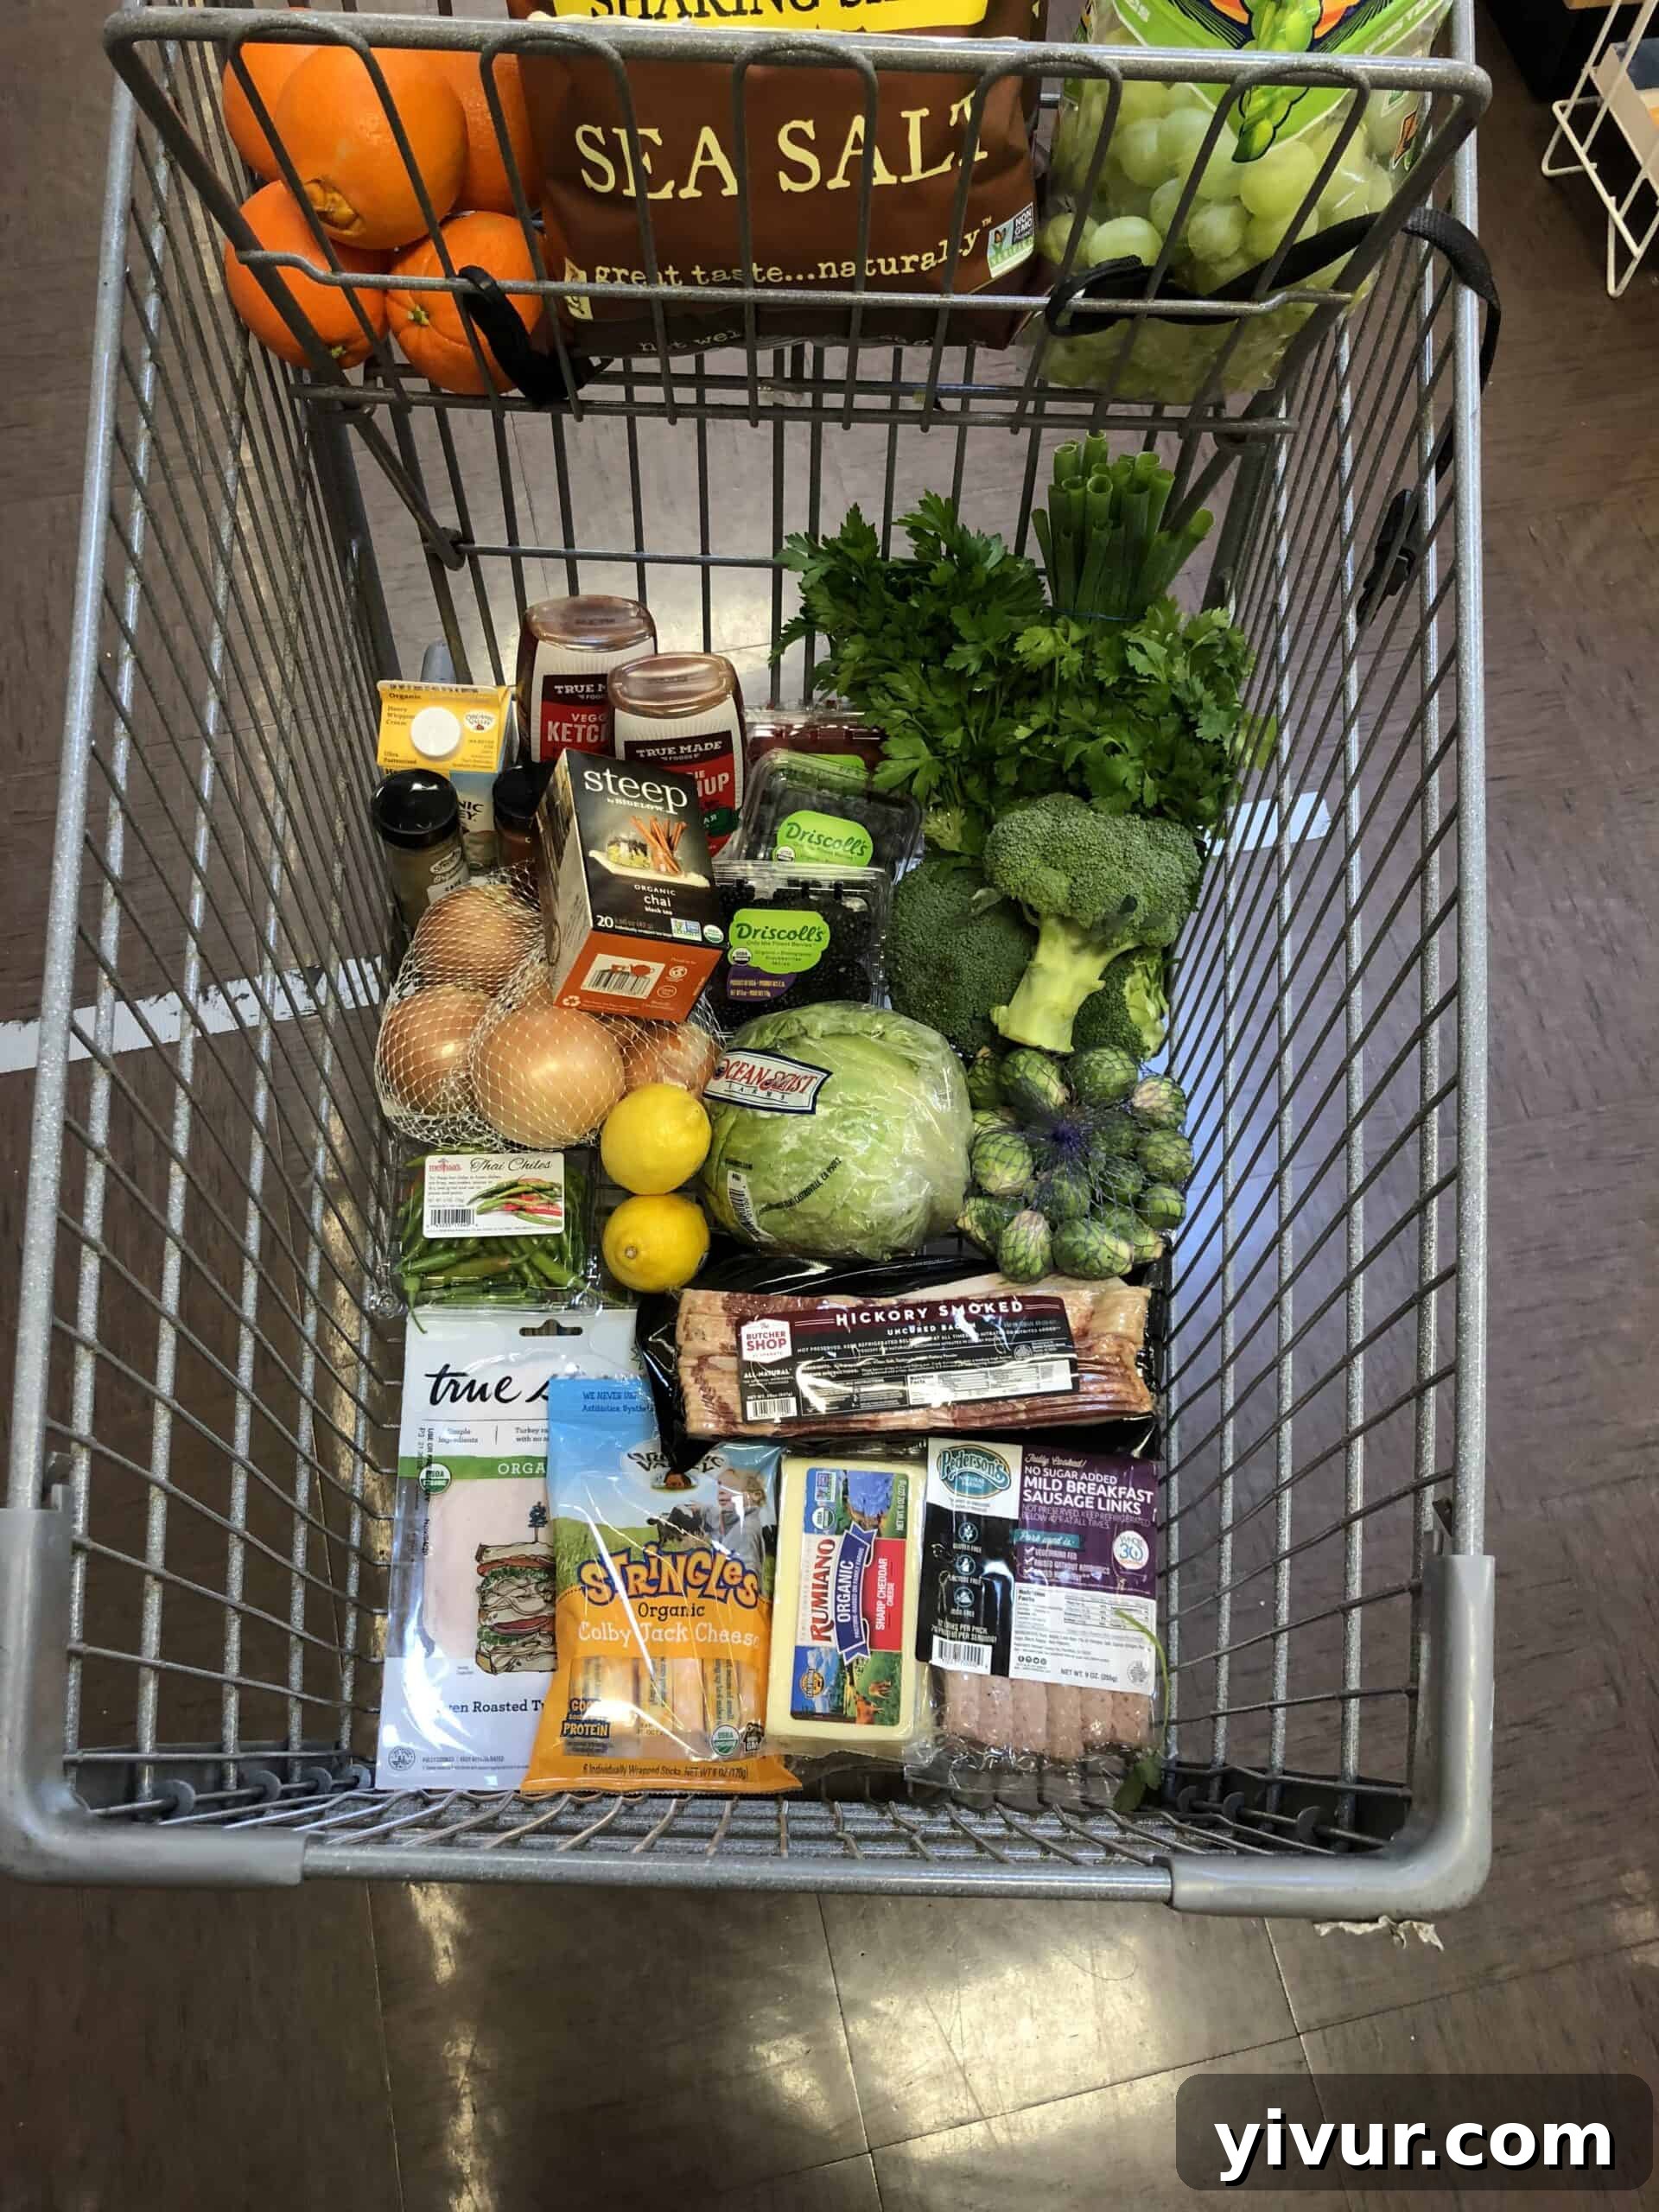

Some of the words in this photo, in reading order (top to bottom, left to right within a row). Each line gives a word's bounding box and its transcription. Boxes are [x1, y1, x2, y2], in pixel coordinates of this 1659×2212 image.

[575, 124, 739, 200] SEA
[554, 683, 595, 695] TRUE
[547, 721, 610, 743] KETC
[636, 747, 677, 758] TRUE
[679, 741, 723, 754] MADE
[583, 767, 689, 816] steep
[785, 822, 868, 857] Driscoll's
[633, 883, 677, 896] ORGANIC
[643, 893, 672, 908] chai
[596, 914, 615, 929] 20
[735, 922, 824, 943] Driscoll's
[469, 1157, 505, 1173] Thai
[507, 1157, 553, 1172] Chiles
[836, 1307, 928, 1326] HICKORY
[938, 1300, 1024, 1317] SMOKED
[746, 1331, 786, 1341] BUTCHER
[887, 1324, 937, 1336] UNCURED
[746, 1338, 787, 1351] SHOP
[423, 1363, 522, 1406] true
[514, 1427, 539, 1435] Turkey
[497, 1461, 548, 1475] ORGA
[939, 1449, 1011, 1491] Pederson's
[1024, 1465, 1041, 1476] NO
[1043, 1467, 1078, 1480] SUGAR
[1080, 1472, 1117, 1485] ADDED
[1023, 1476, 1063, 1491] MILD
[1065, 1479, 1154, 1504] BREAKFAST
[1022, 1490, 1095, 1510] SAUSAGE
[1097, 1498, 1141, 1515] LINKS
[877, 1558, 888, 1599] CHEDDAR
[810, 1538, 836, 1643] RUMIANO
[836, 1560, 854, 1623] ORGANIC
[887, 1582, 895, 1607] CHEESE
[638, 1602, 706, 1622] Organic
[875, 1600, 887, 1630] SHARP
[578, 1621, 632, 1648] Colby
[639, 1621, 690, 1643] Jack
[1060, 1668, 1073, 1676] NET
[473, 1700, 528, 1713] Roasted
[628, 1764, 659, 1776] Wrapped
